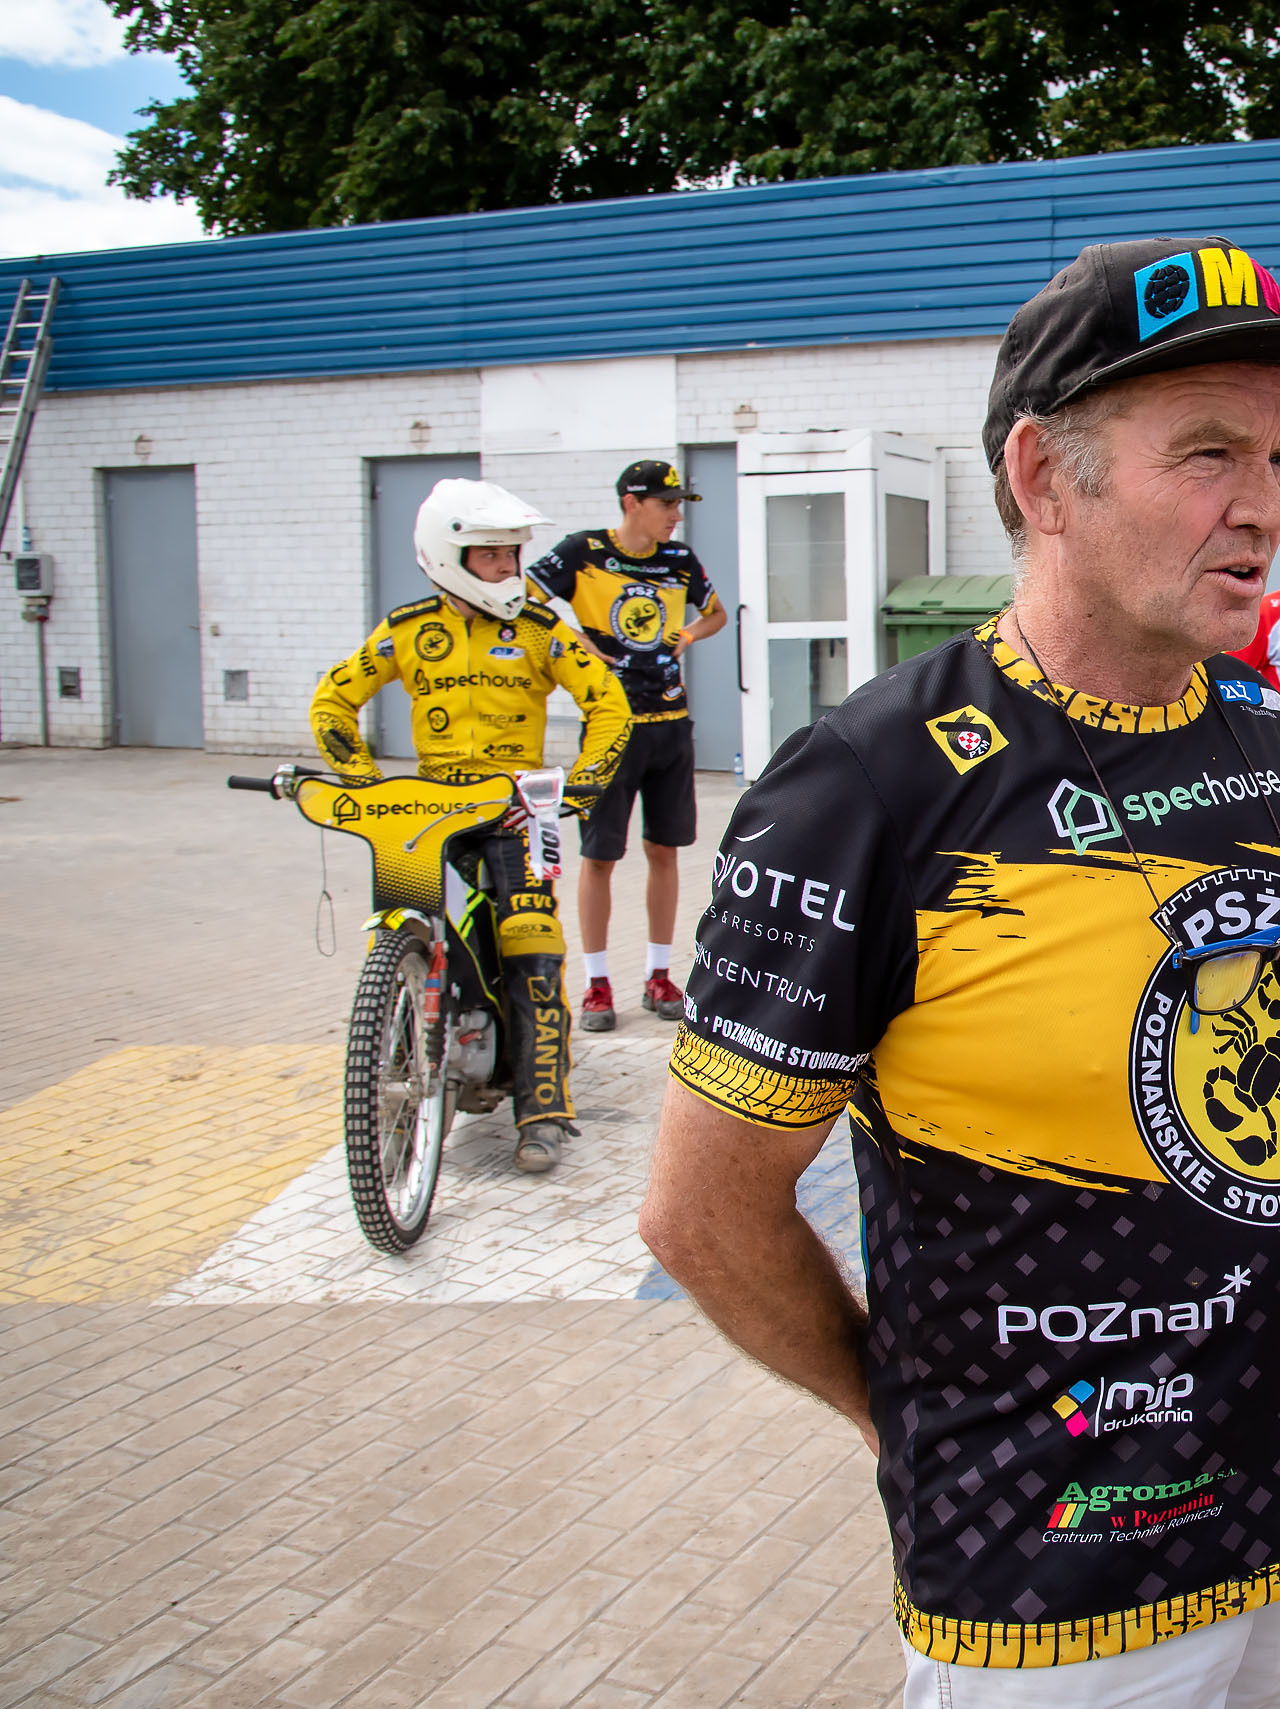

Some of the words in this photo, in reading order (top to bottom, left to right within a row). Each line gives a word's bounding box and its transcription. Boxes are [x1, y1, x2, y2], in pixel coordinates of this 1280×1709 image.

[434, 671, 532, 692] spechouse
[968, 740, 991, 758] PZM
[365, 799, 478, 819] spechouse
[731, 914, 816, 952] RESORTS
[716, 957, 827, 1012] CENTRUM
[534, 1007, 560, 1105] SANTO
[712, 1014, 788, 1063] POZNAŃSKIE
[1142, 991, 1217, 1195] POZNAŃSKIE
[1104, 1373, 1194, 1412] mjp
[1103, 1408, 1193, 1432] drukarnia
[1056, 1472, 1215, 1512] Agroma
[1216, 1467, 1238, 1481] S.A.
[1042, 1530, 1103, 1543] Centrum
[1109, 1522, 1165, 1543] Techniki
[1167, 1502, 1224, 1530] Rolniczej
[1110, 1515, 1127, 1529] w
[1134, 1492, 1214, 1528] Poznaniu
